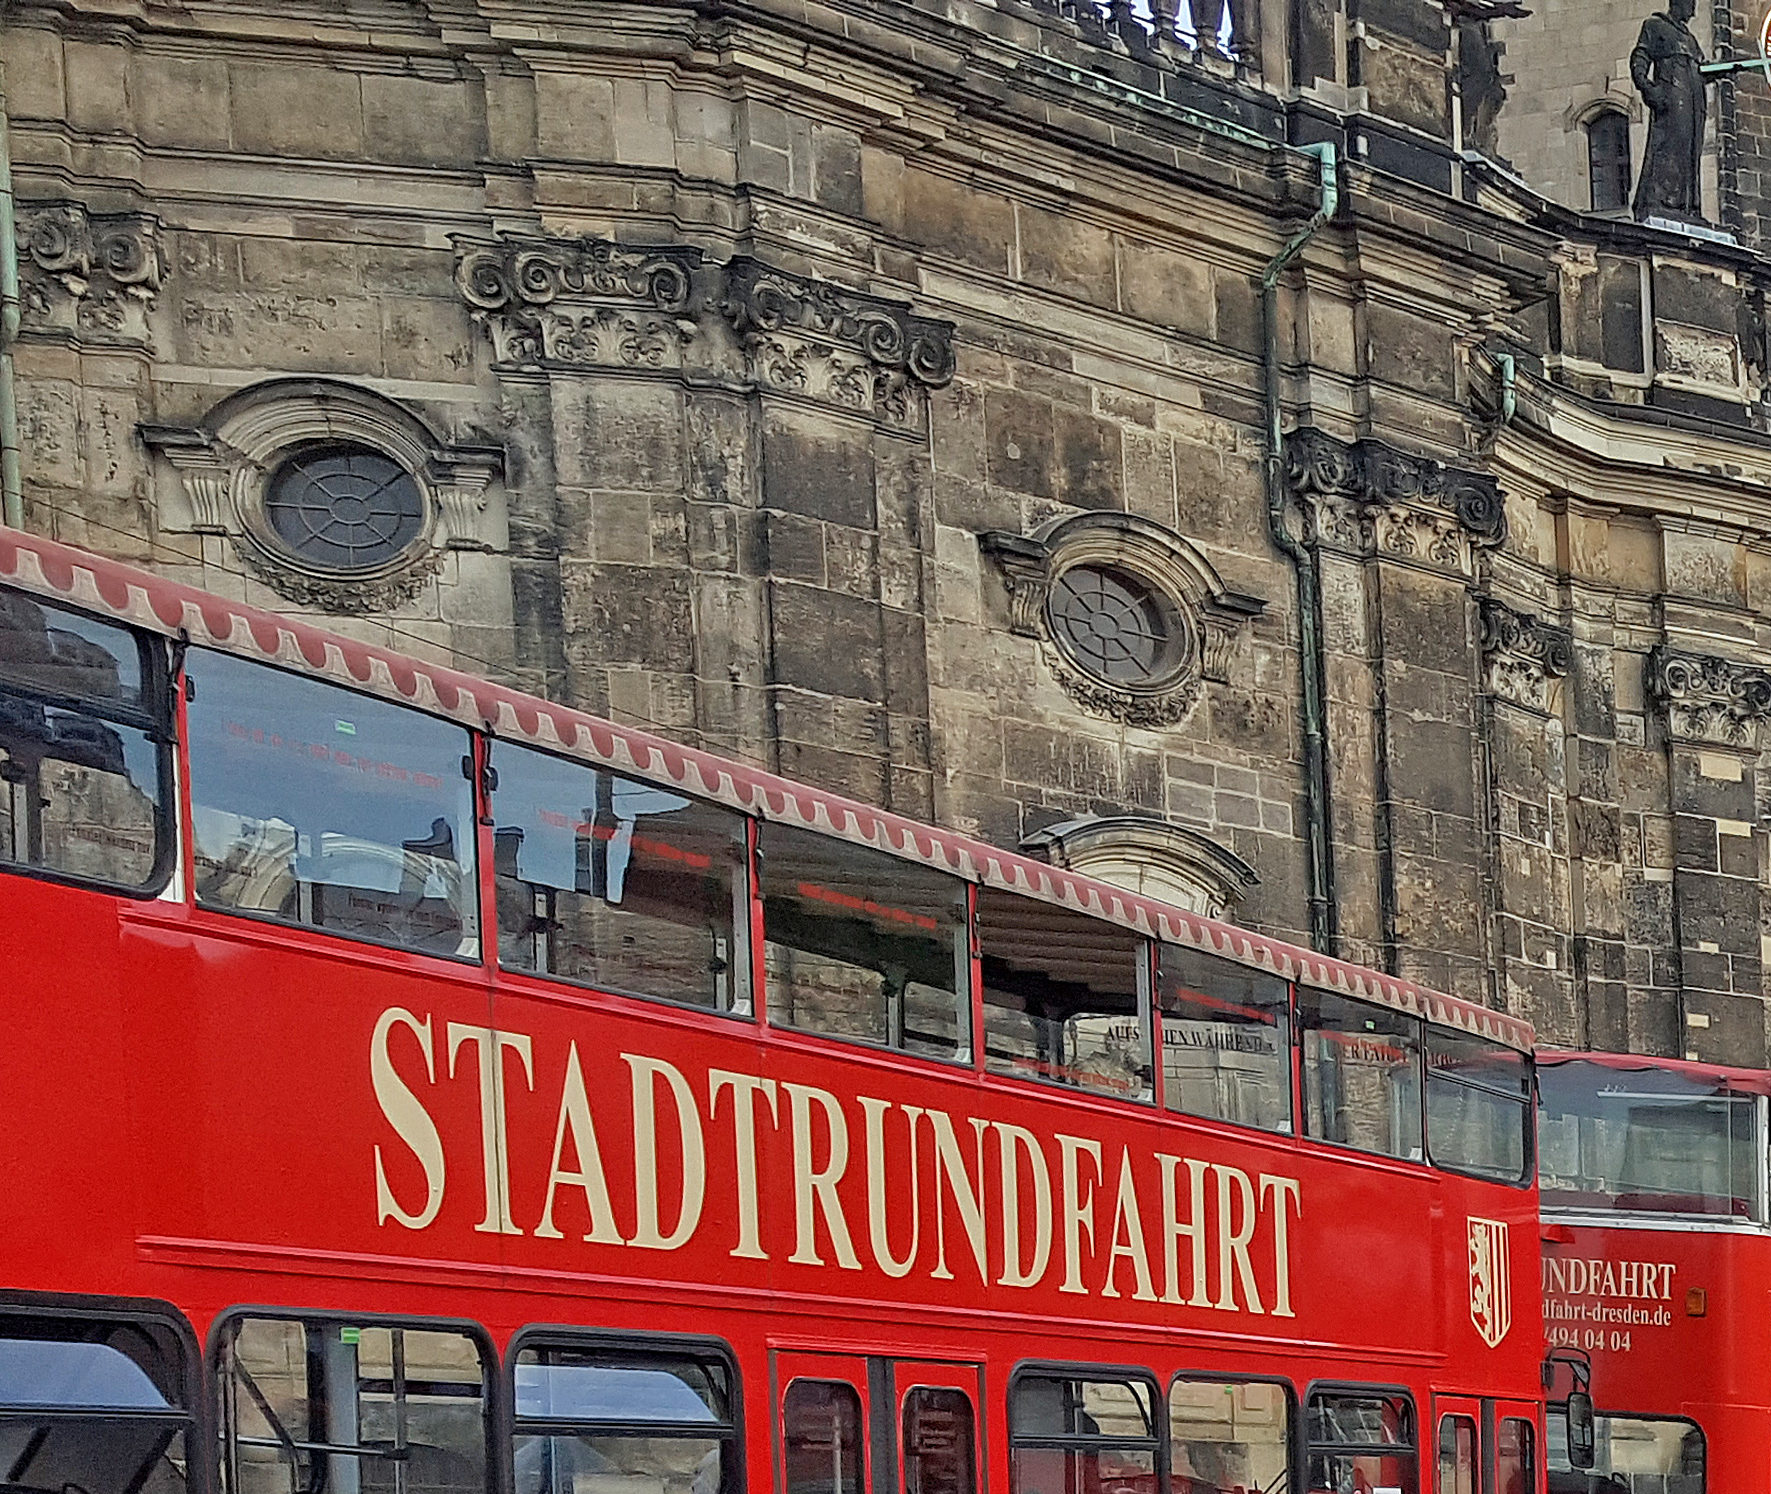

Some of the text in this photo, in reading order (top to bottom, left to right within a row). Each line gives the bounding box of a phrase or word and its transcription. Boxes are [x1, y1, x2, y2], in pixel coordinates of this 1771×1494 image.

[370, 1006, 1302, 1318] STADTRUNDFAHRT
[1584, 1329, 1605, 1350] 04
[1610, 1331, 1632, 1351] 04
